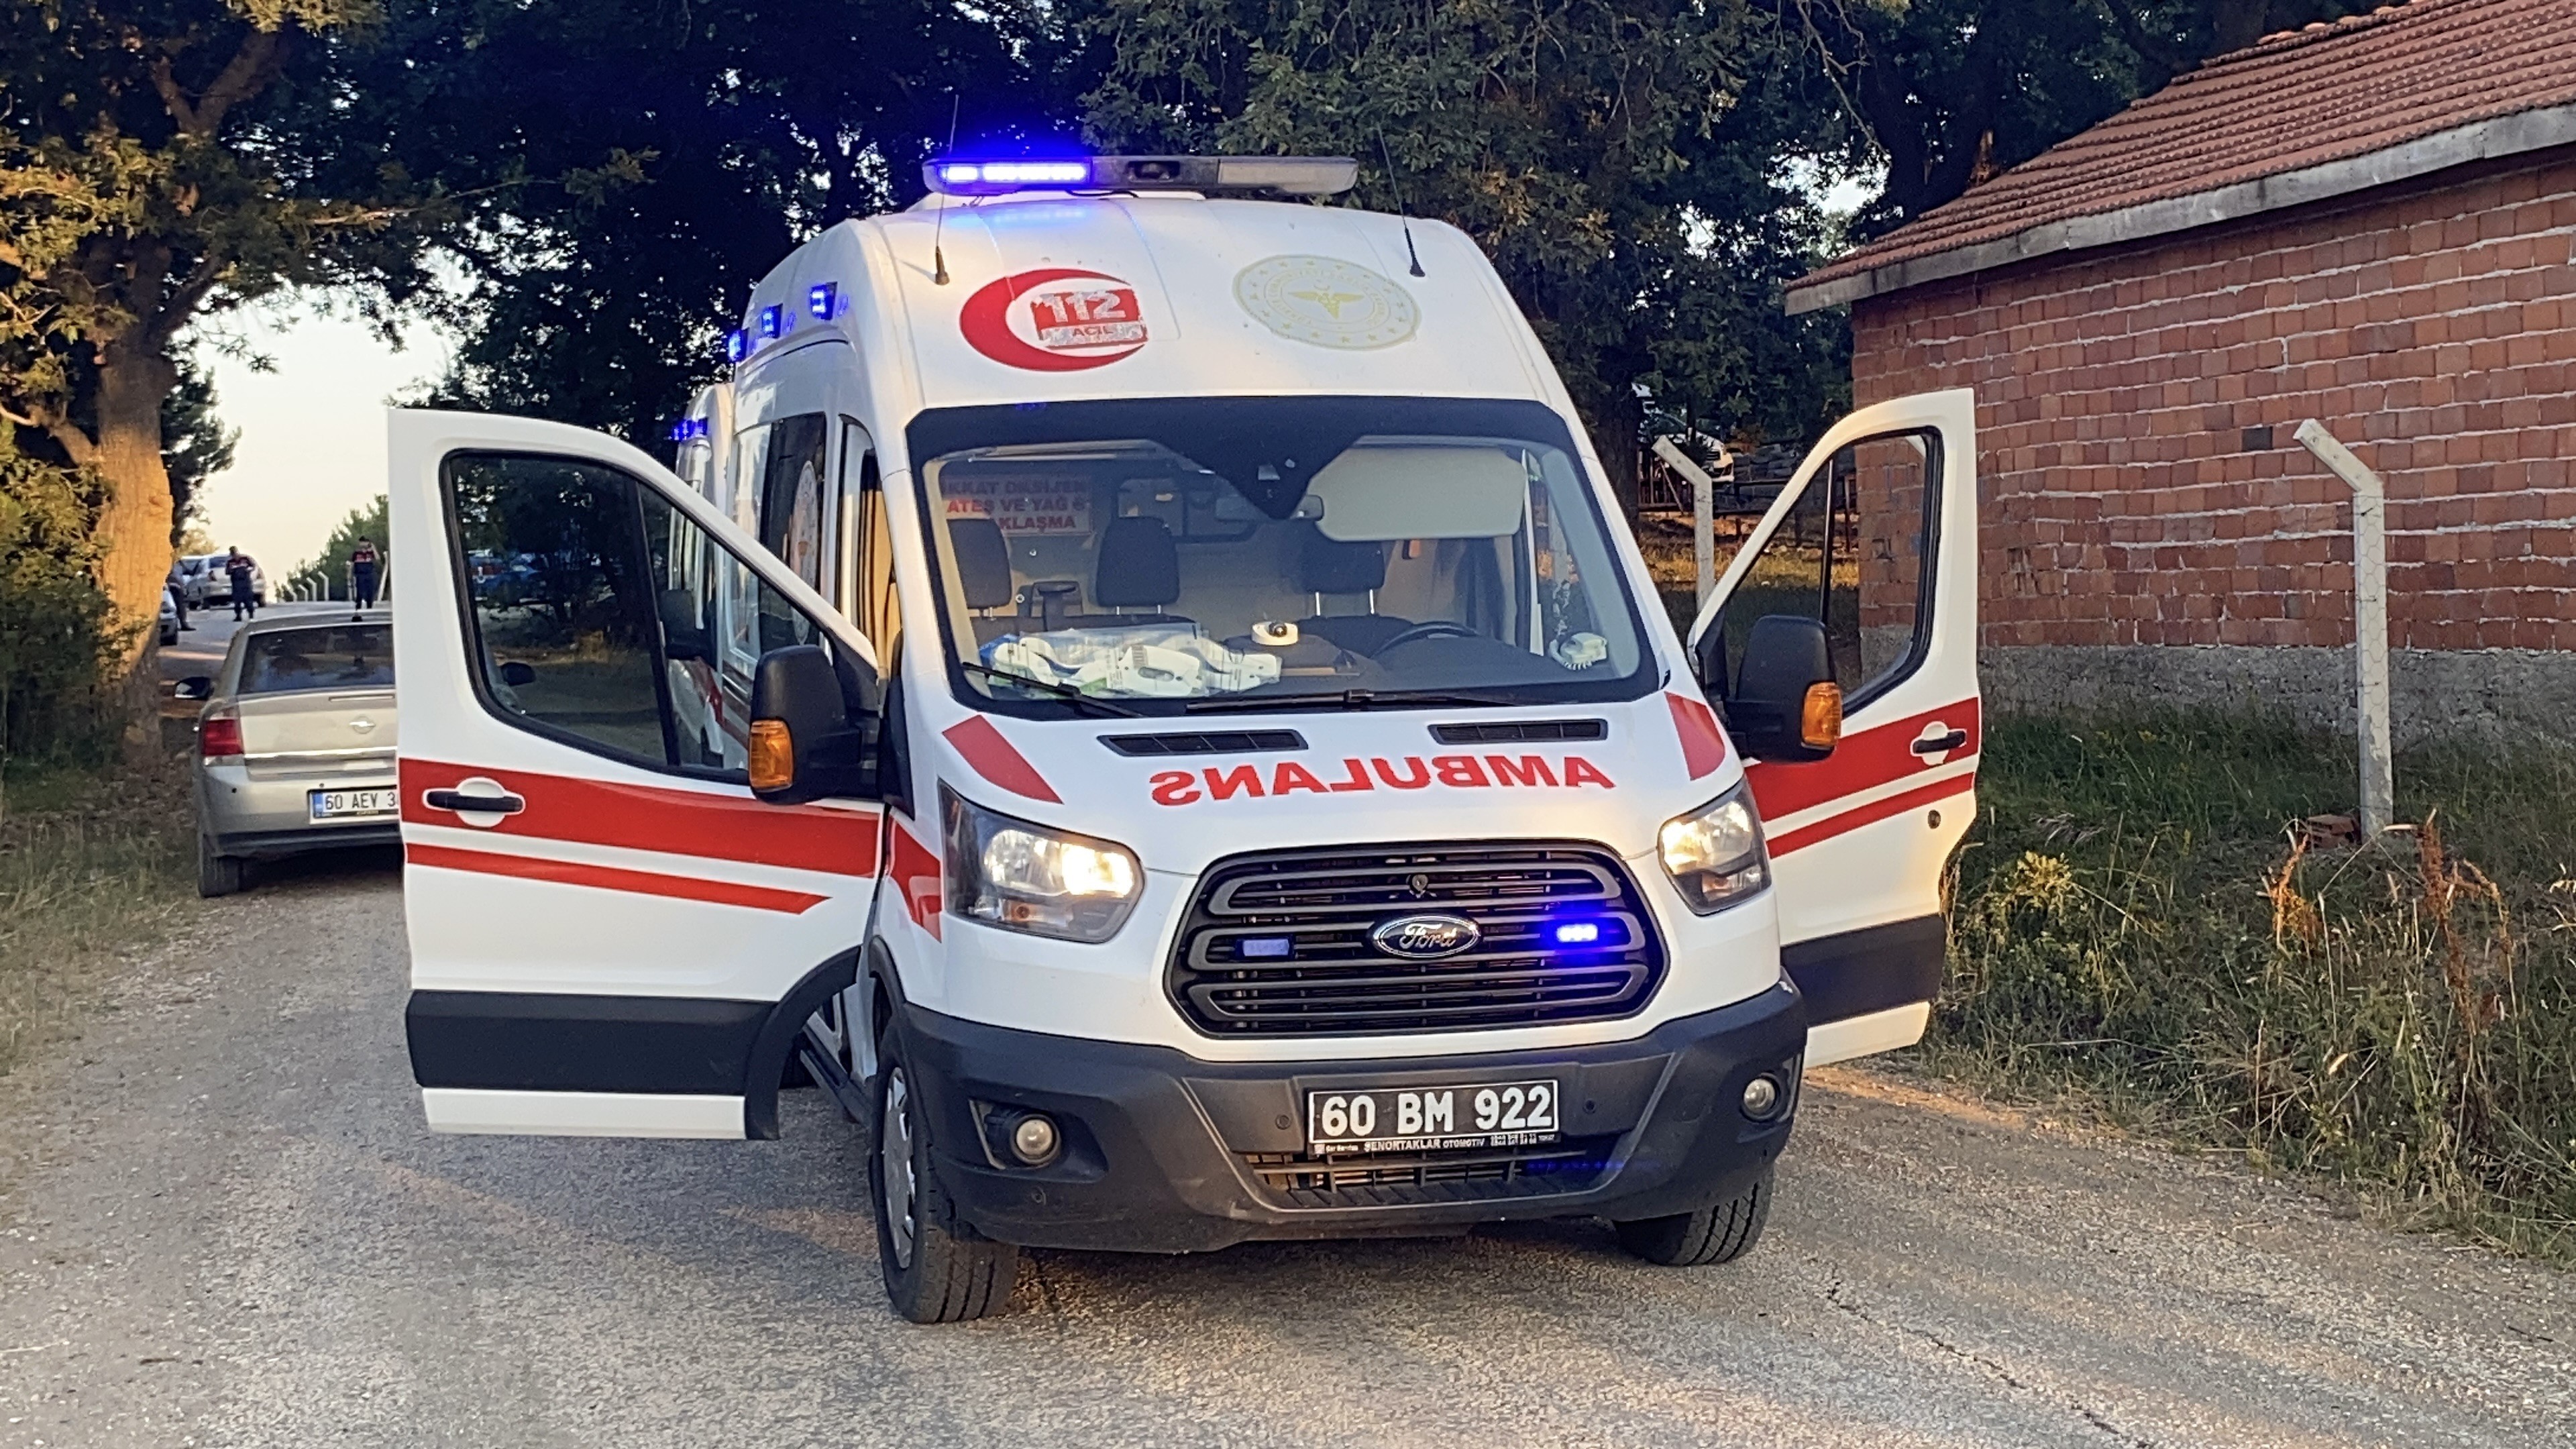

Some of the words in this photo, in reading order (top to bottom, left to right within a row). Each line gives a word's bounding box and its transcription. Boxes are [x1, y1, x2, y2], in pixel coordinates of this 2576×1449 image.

[1040, 290, 1126, 323] 112
[1000, 499, 1027, 512] VE
[325, 794, 343, 810] 60
[352, 792, 378, 808] AEV
[387, 792, 399, 807] 3
[1399, 924, 1457, 949] Ford
[1322, 1095, 1376, 1136] 60
[1397, 1091, 1454, 1134] BM
[1475, 1085, 1552, 1130] 922
